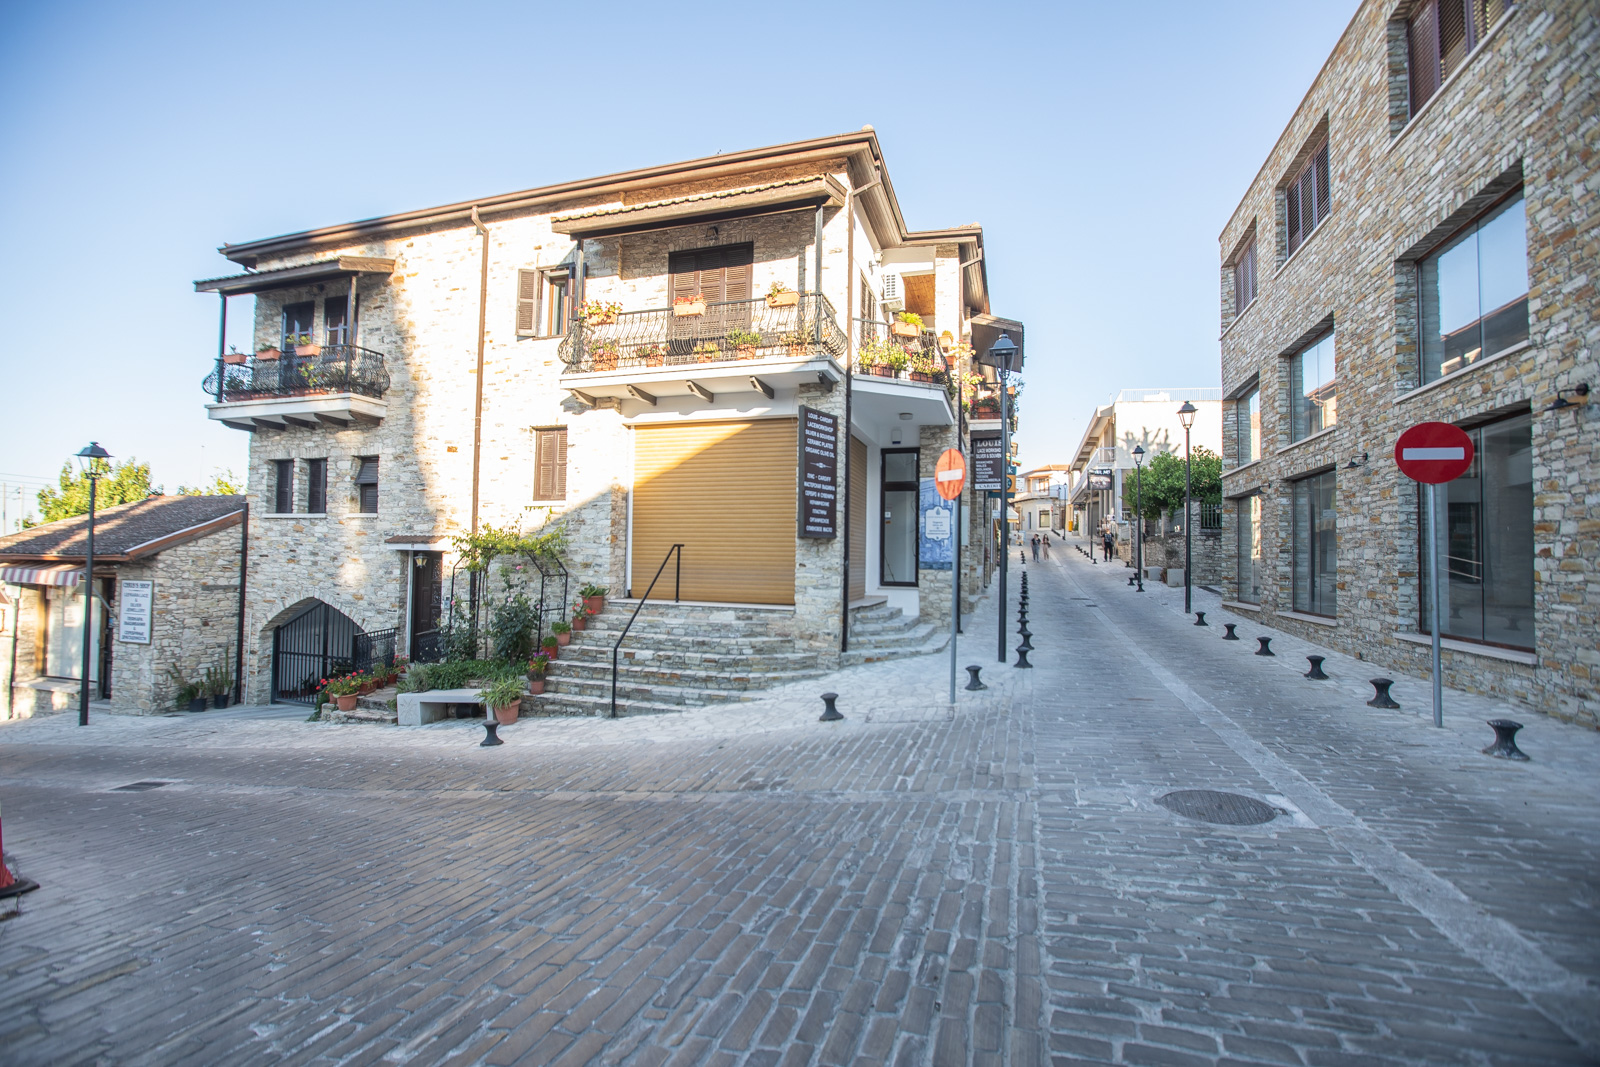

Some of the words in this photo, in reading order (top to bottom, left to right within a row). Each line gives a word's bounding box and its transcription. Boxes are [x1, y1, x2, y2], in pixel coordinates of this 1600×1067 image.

[808, 412, 818, 420] LOUIS
[820, 416, 833, 424] CARDIFF
[807, 438, 821, 446] CERAMIC
[822, 441, 833, 449] PLATES
[805, 446, 820, 455] ORGANIC
